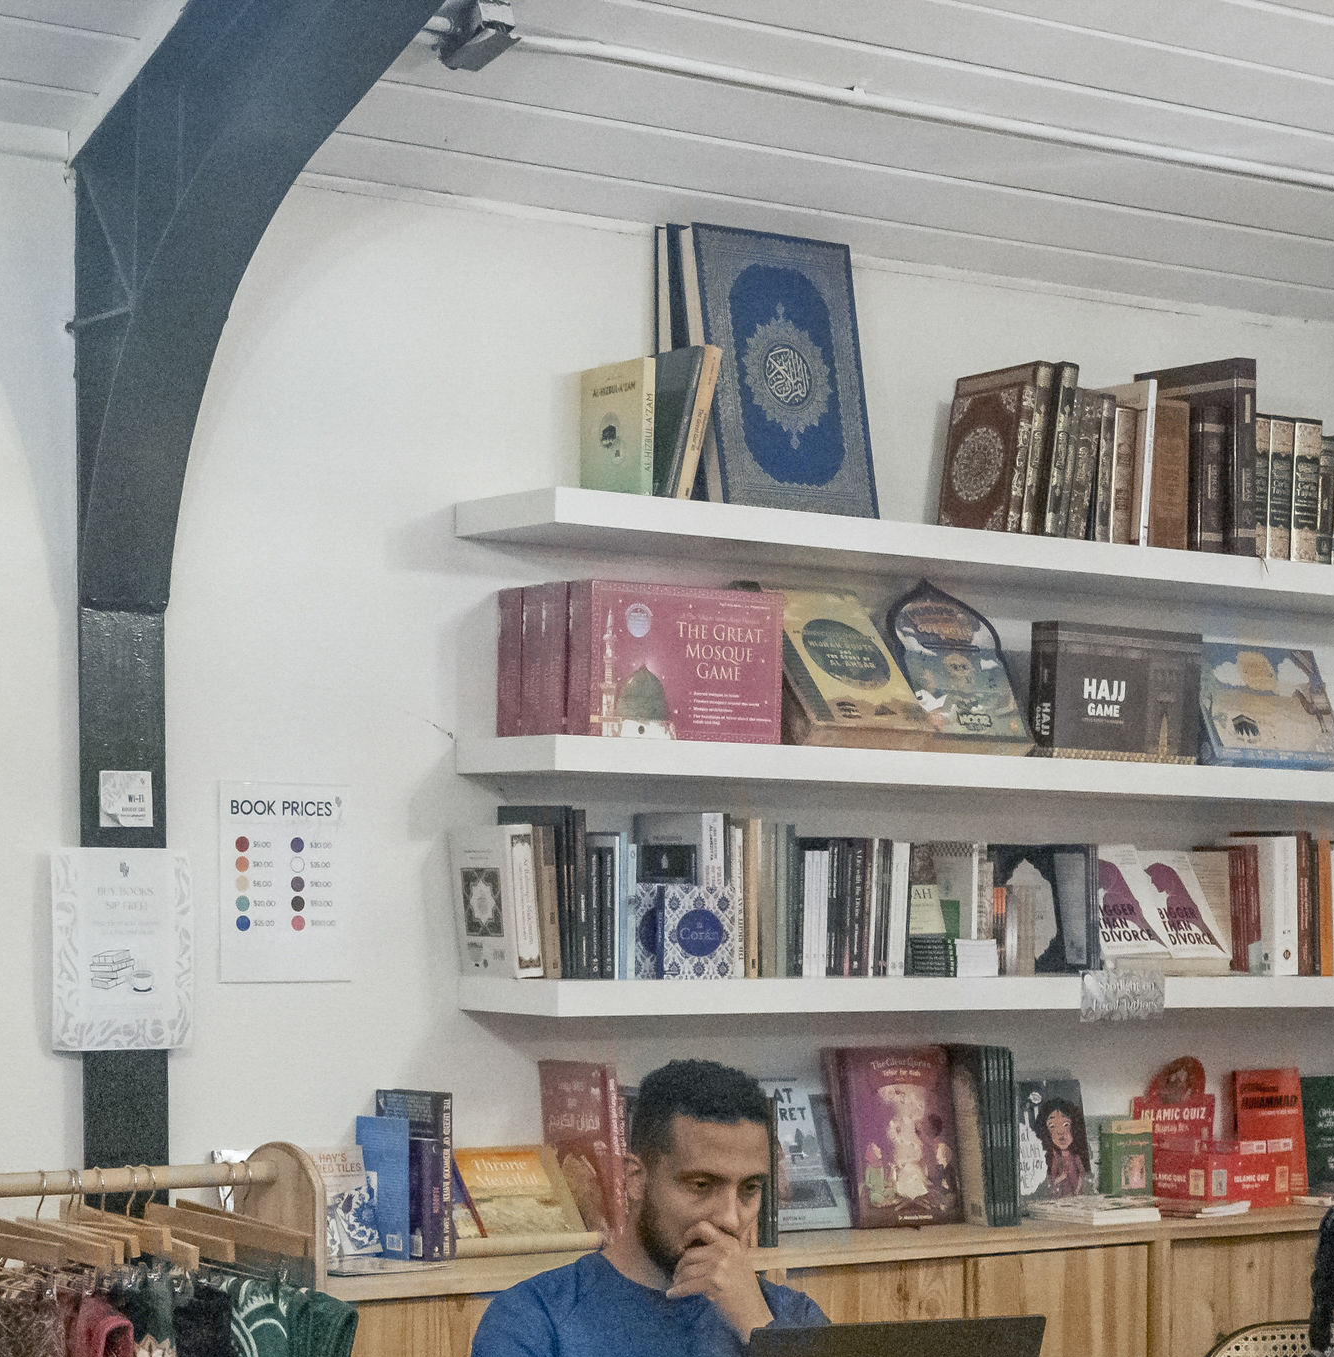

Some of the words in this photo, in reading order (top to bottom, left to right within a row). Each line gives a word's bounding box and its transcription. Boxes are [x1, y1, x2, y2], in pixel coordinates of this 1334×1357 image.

[676, 621, 708, 640] THE
[713, 624, 764, 644] GREAT
[686, 643, 754, 666] MOSQUE
[696, 662, 741, 682] GAME
[1082, 678, 1126, 702] HAJJ
[1087, 702, 1121, 718] GAME
[1041, 702, 1051, 736] HAJJ
[230, 800, 276, 815] BOOK
[282, 801, 333, 817] PRICES
[913, 888, 933, 900] AH
[1099, 903, 1137, 917] IGGER
[1157, 908, 1199, 921] BIGGER
[1162, 920, 1193, 933] THAN
[1101, 929, 1156, 943] DIVORCE
[1168, 933, 1216, 946] DIVORCE
[1142, 982, 1156, 990] on
[1140, 1107, 1181, 1121] ISLAMIC
[1182, 1106, 1207, 1120] QUIZ
[319, 1151, 348, 1163] HAY'S
[336, 1162, 362, 1172] TILES
